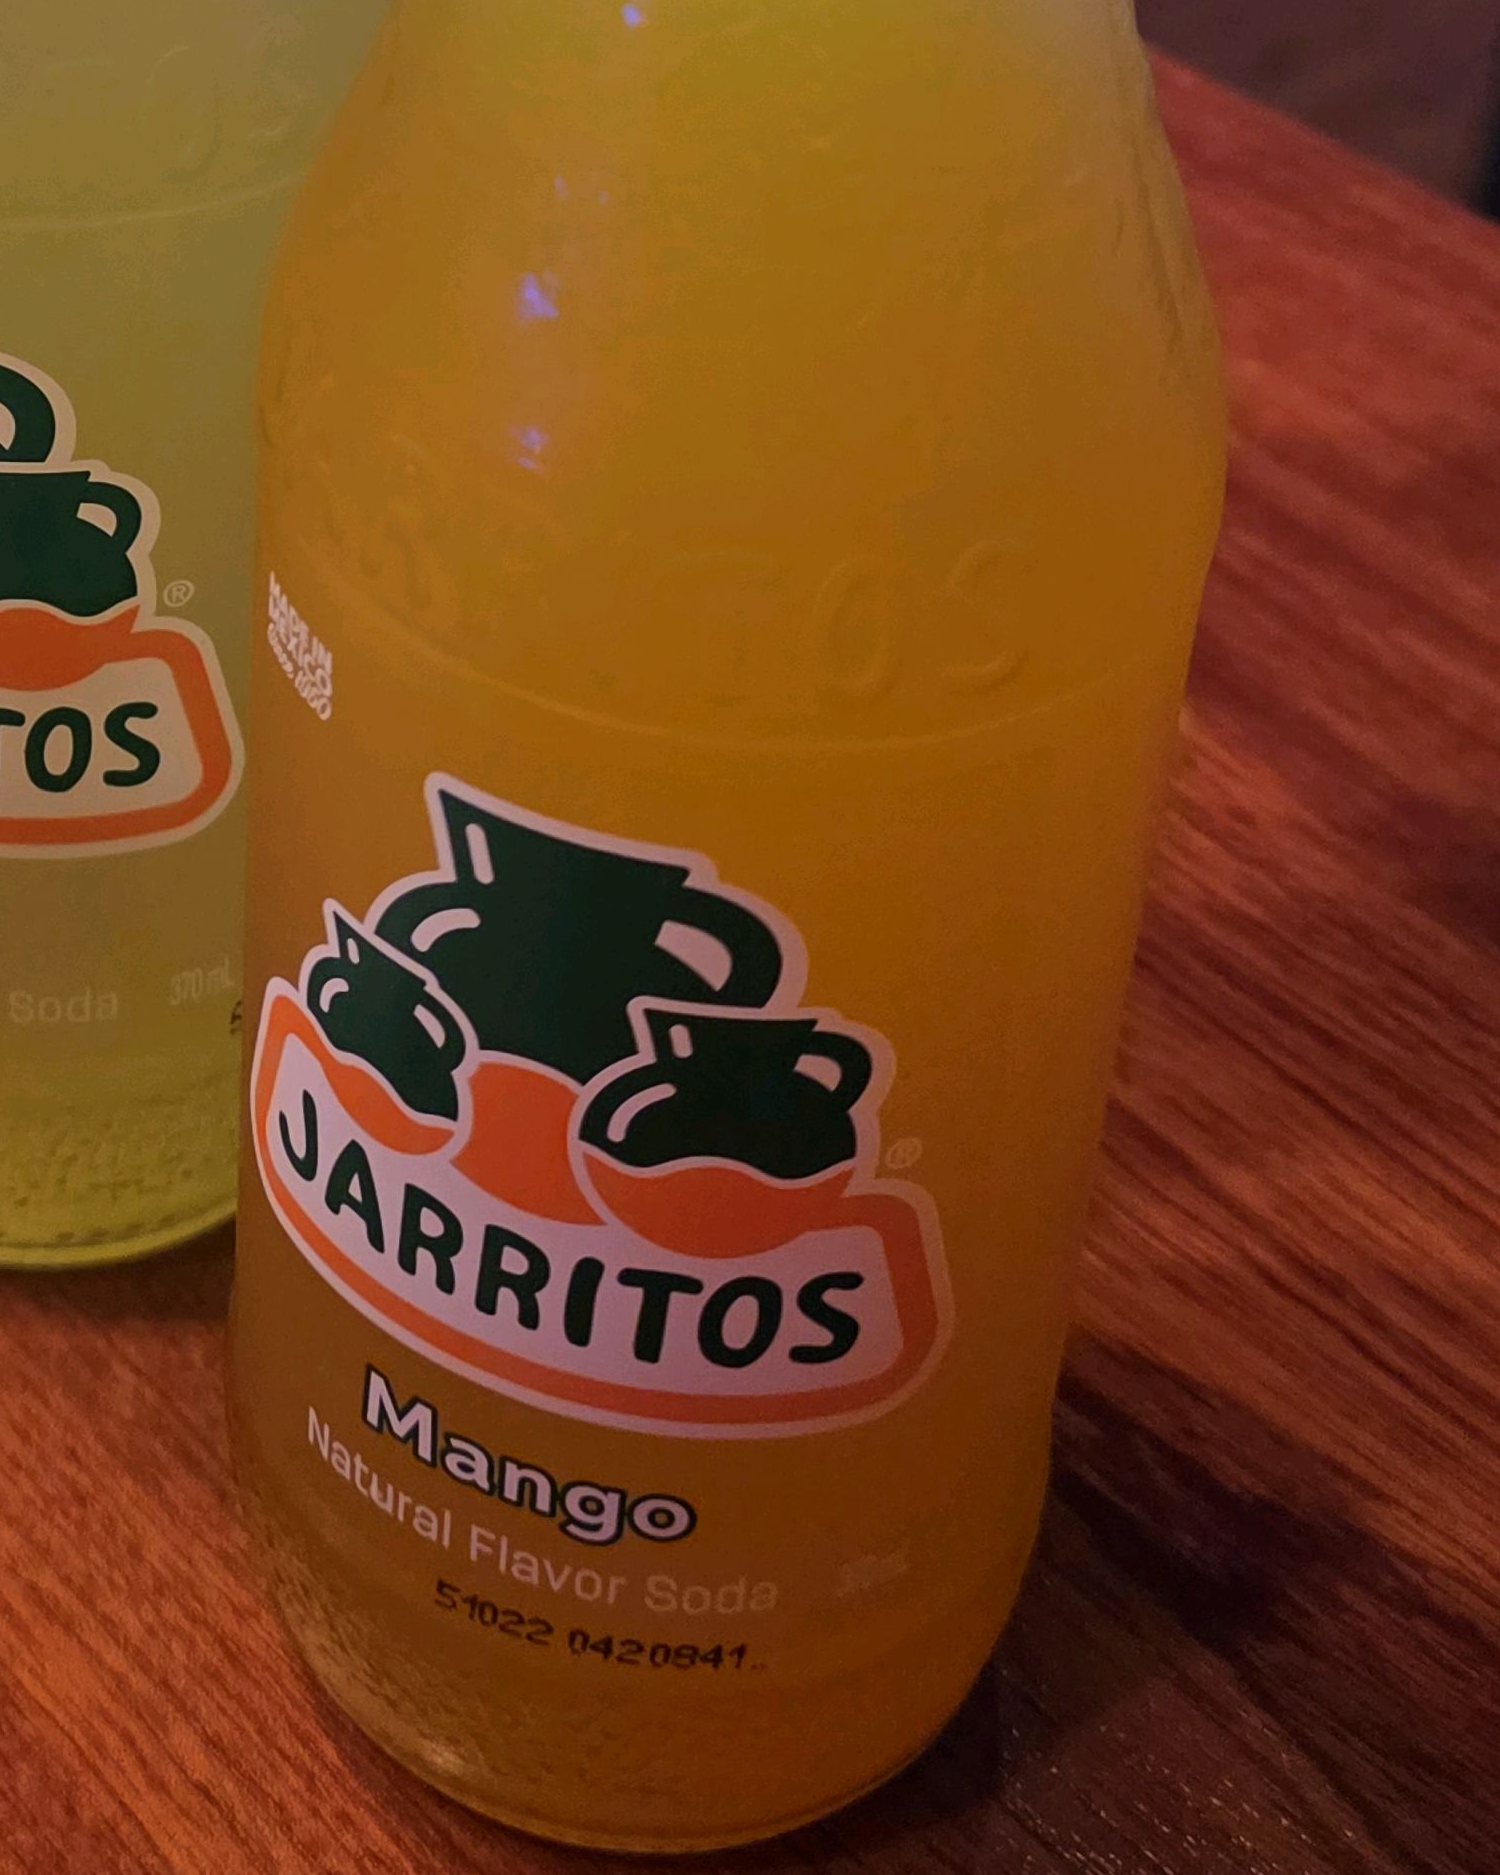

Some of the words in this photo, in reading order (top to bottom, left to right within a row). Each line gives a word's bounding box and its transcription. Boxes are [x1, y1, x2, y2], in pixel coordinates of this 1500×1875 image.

[8, 986, 120, 1027] Soda
[278, 1087, 865, 1369] JARRITOS
[307, 1404, 453, 1551] Natural
[467, 1523, 628, 1607] Flavor
[643, 1573, 780, 1617] Soda
[361, 1362, 698, 1546] Mango
[434, 1578, 555, 1647] 51022
